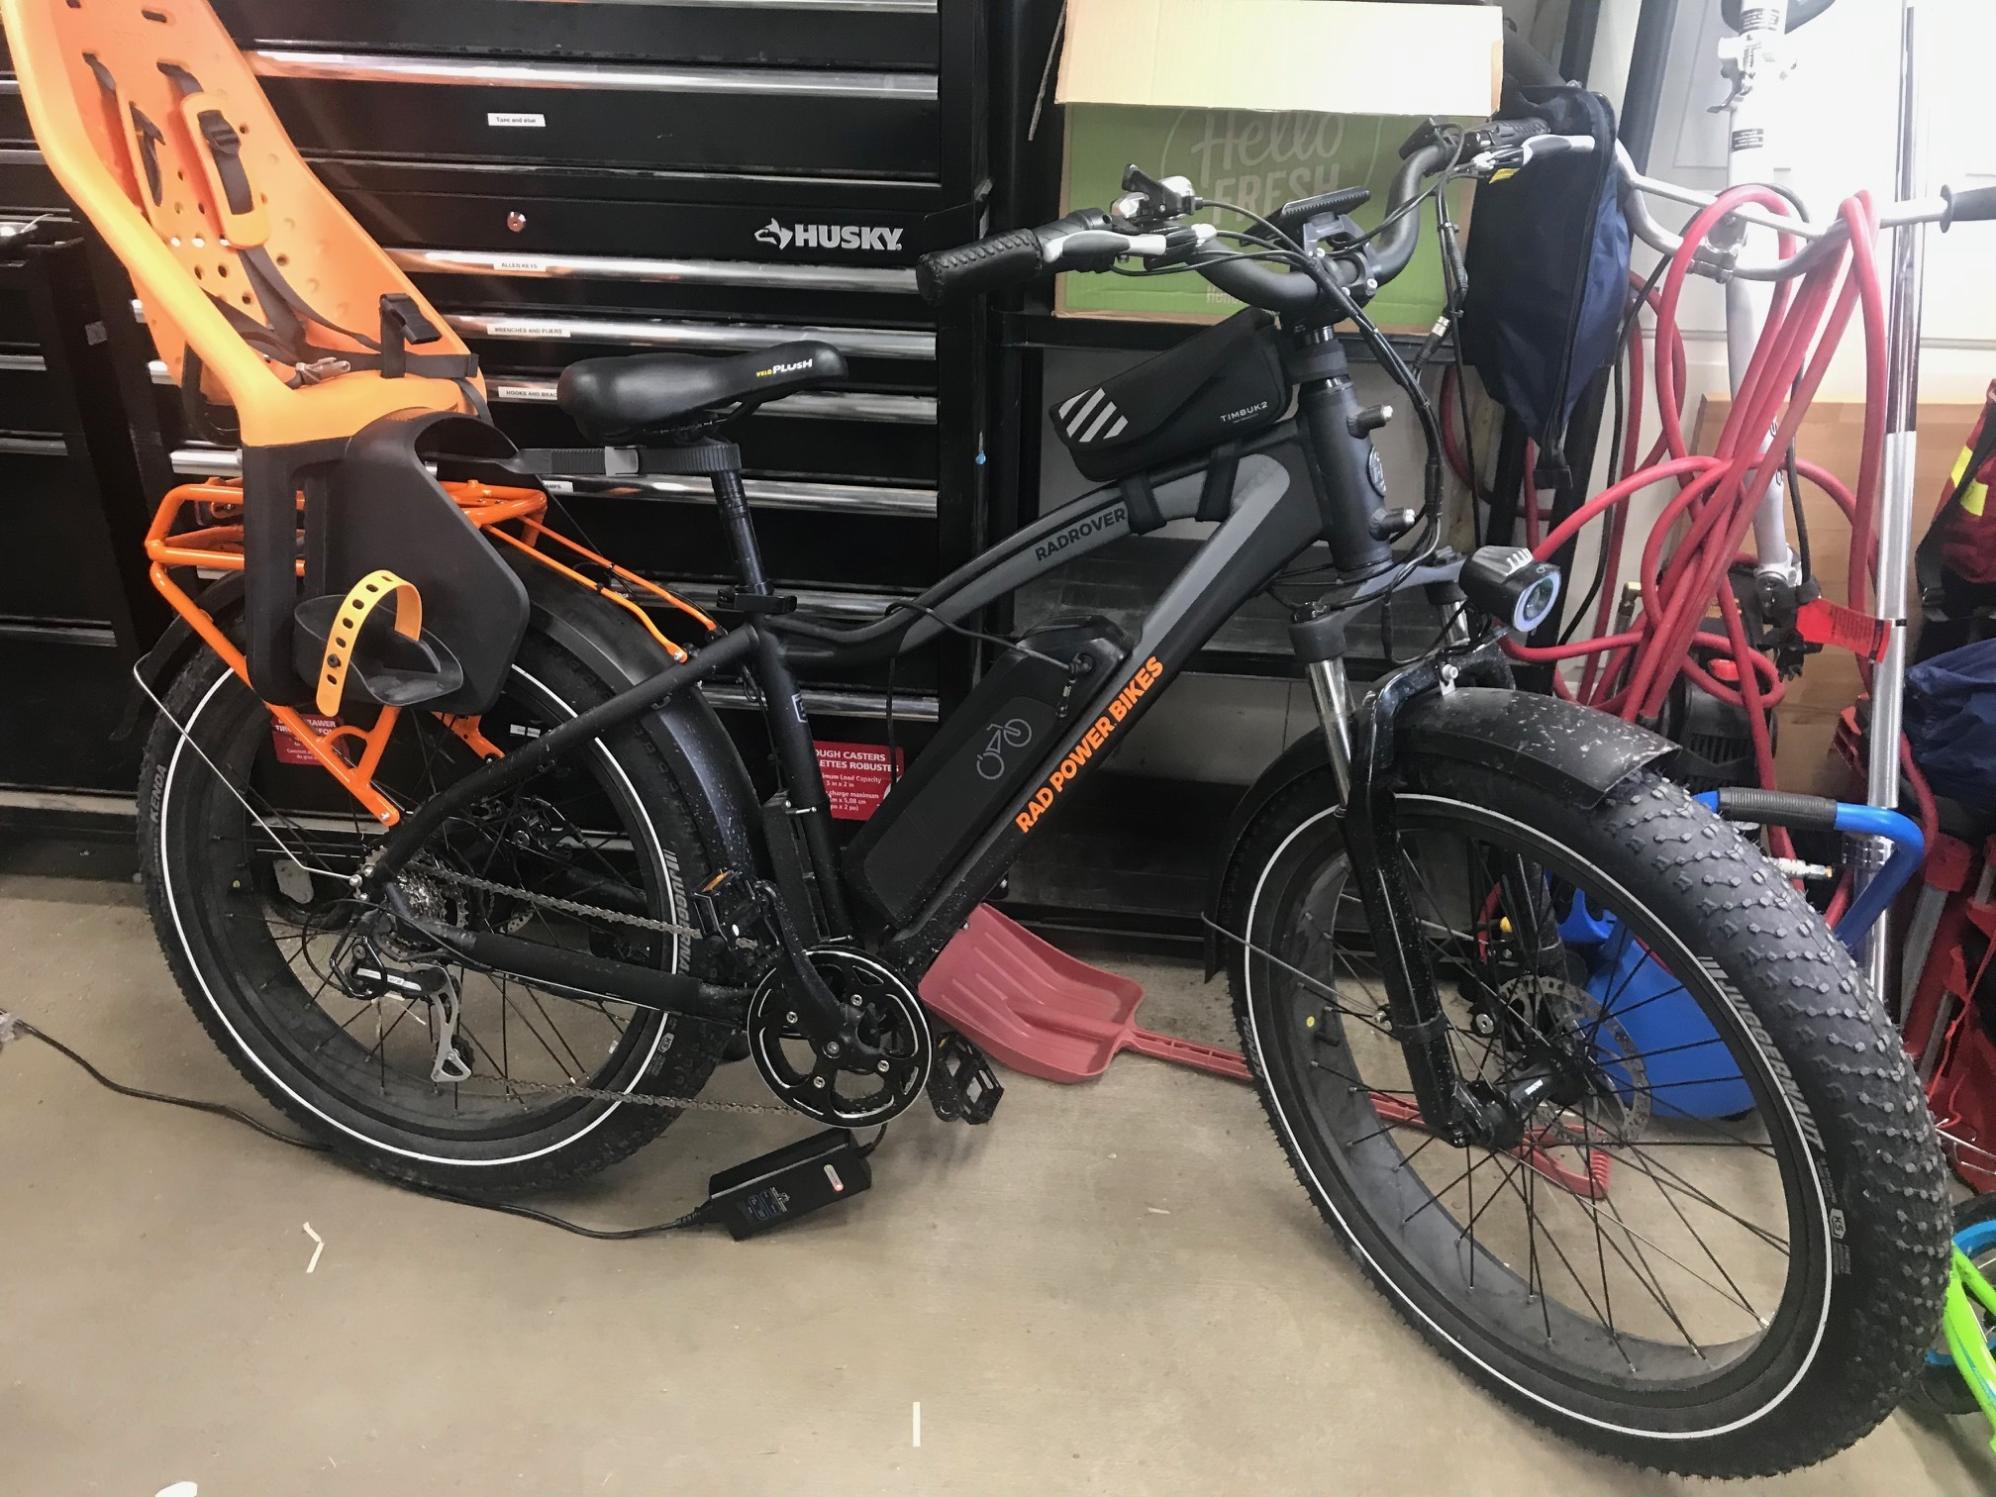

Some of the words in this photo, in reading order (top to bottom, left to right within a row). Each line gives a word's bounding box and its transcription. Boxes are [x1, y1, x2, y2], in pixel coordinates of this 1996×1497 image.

[794, 224, 904, 251] HUSKY
[772, 358, 813, 375] PLUSH
[1220, 401, 1268, 422] TIMBUK2
[1034, 507, 1126, 562] RADROVER
[1015, 787, 1055, 833] RAD
[1049, 715, 1116, 793] POWER
[1107, 655, 1164, 723] BIKES
[842, 751, 886, 762] CASTERS
[849, 762, 899, 773] ROBUSTE
[856, 776, 881, 784] Capacity
[150, 763, 167, 824] KENDA
